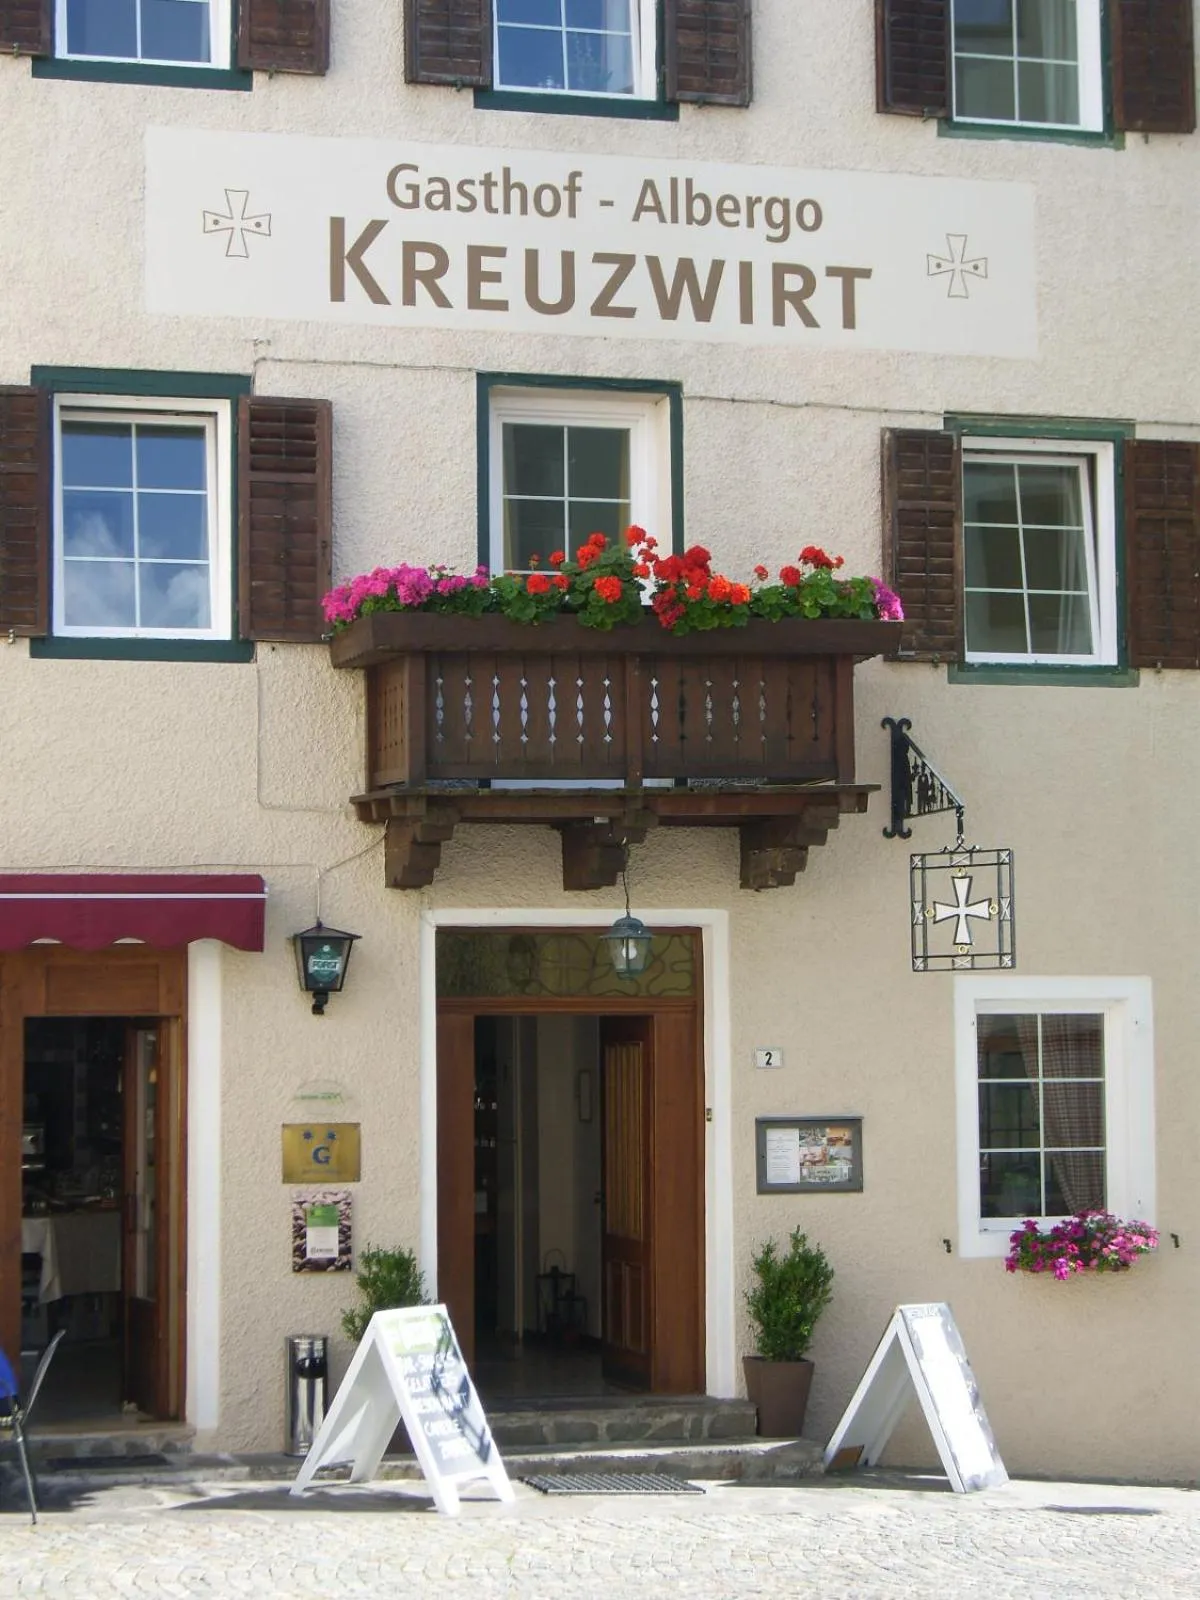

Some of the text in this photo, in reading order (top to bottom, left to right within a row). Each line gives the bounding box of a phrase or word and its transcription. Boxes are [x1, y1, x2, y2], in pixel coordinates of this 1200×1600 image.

[386, 163, 583, 219] Gasthof
[632, 177, 824, 244] Albergo
[329, 216, 873, 331] KREUZWIRT
[765, 1051, 773, 1066] 2
[312, 1145, 331, 1165] G
